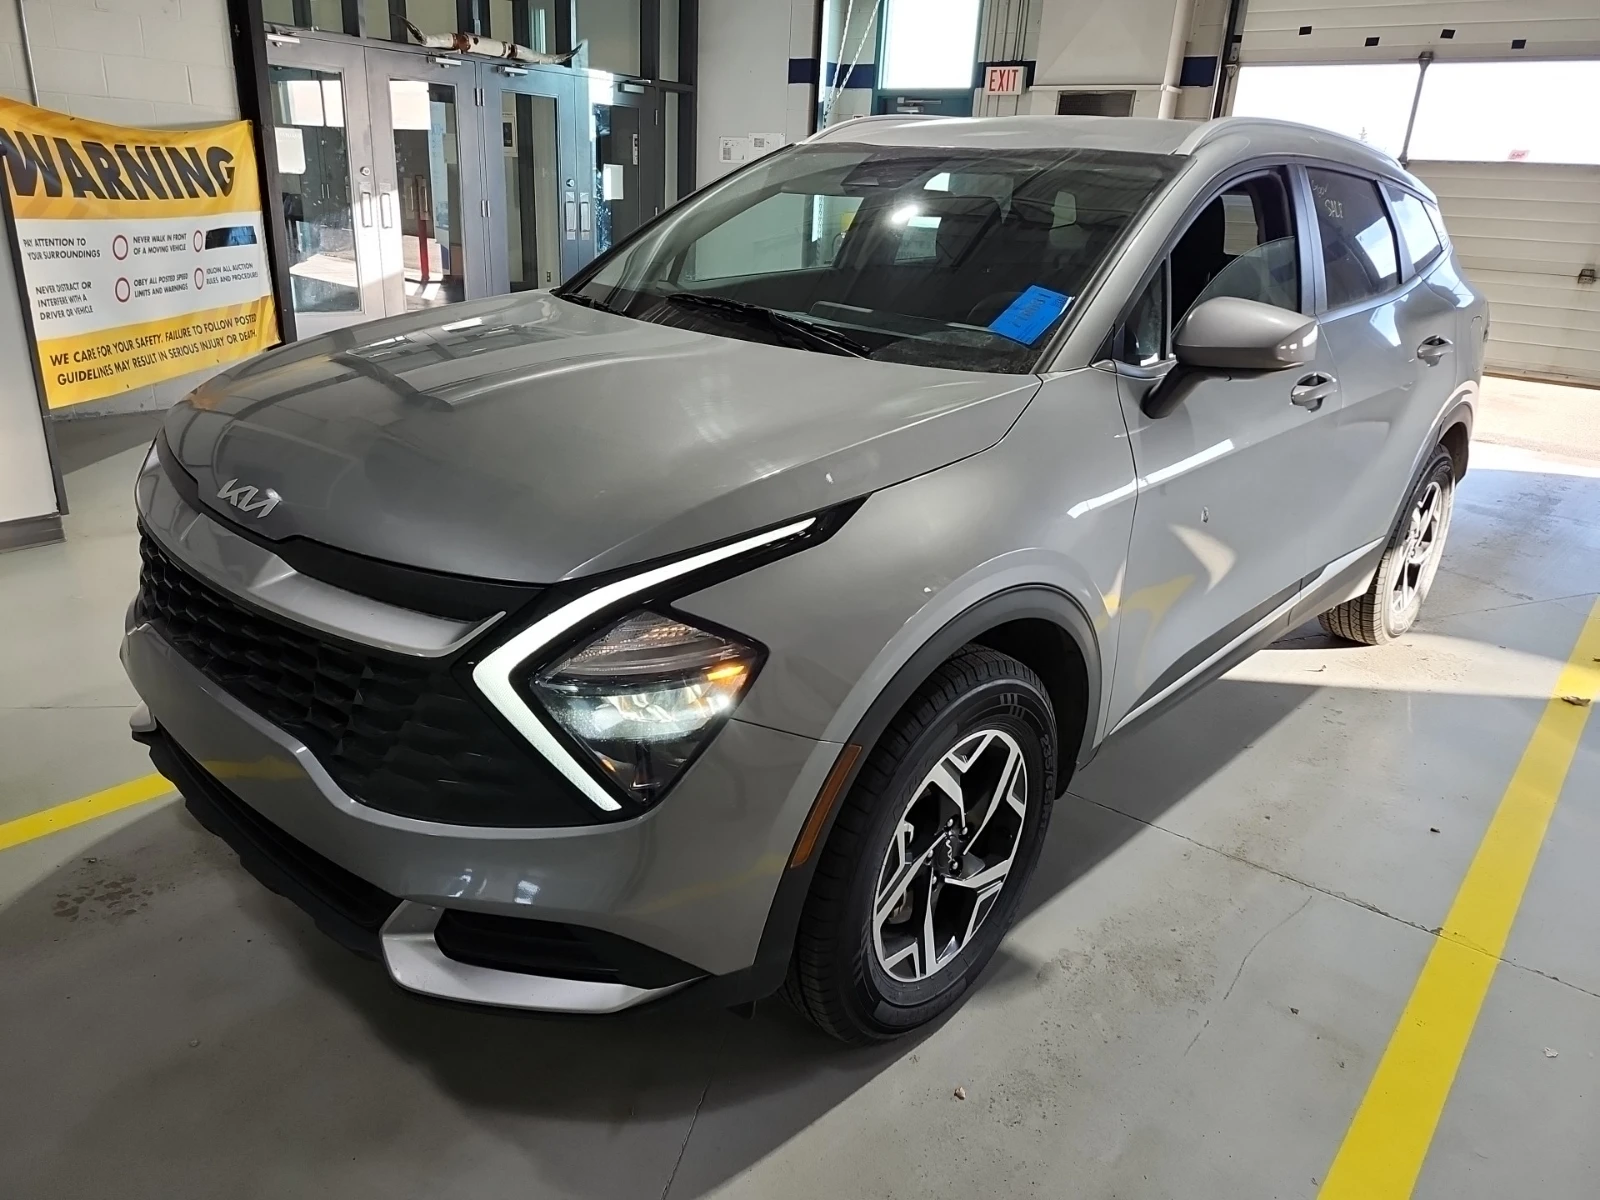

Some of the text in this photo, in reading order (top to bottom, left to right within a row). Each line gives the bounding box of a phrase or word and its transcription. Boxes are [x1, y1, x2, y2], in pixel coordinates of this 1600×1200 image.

[989, 69, 1018, 91] EXIT
[0, 127, 235, 200] WARNING
[23, 238, 87, 247] PAY ATTENTION TO
[133, 236, 150, 244] NEVER
[27, 249, 101, 260] YOUR SURROUNDINGS
[133, 244, 187, 255] OF A MOVING VEHICLE
[222, 265, 231, 273] ALL
[232, 262, 253, 271] AUCTION
[133, 273, 188, 287] OBEY ALL POSTED SPEED
[220, 275, 231, 283] AND
[36, 281, 92, 295] NEVER DISTRACT OR
[134, 283, 189, 298] LIMITS AND WARNINGS
[38, 294, 88, 308] INTERFERE WITH A
[39, 305, 94, 321] DRIVER OR VEHICLE
[50, 313, 257, 366] WE CARE FOR YOUR SAFETY. FAILURE TO FOLLOW POSTED
[57, 329, 257, 386] GUIDELINES MAY RESULT IN SERIOUS INJURY OR DEATH.
[217, 478, 281, 518] KIA
